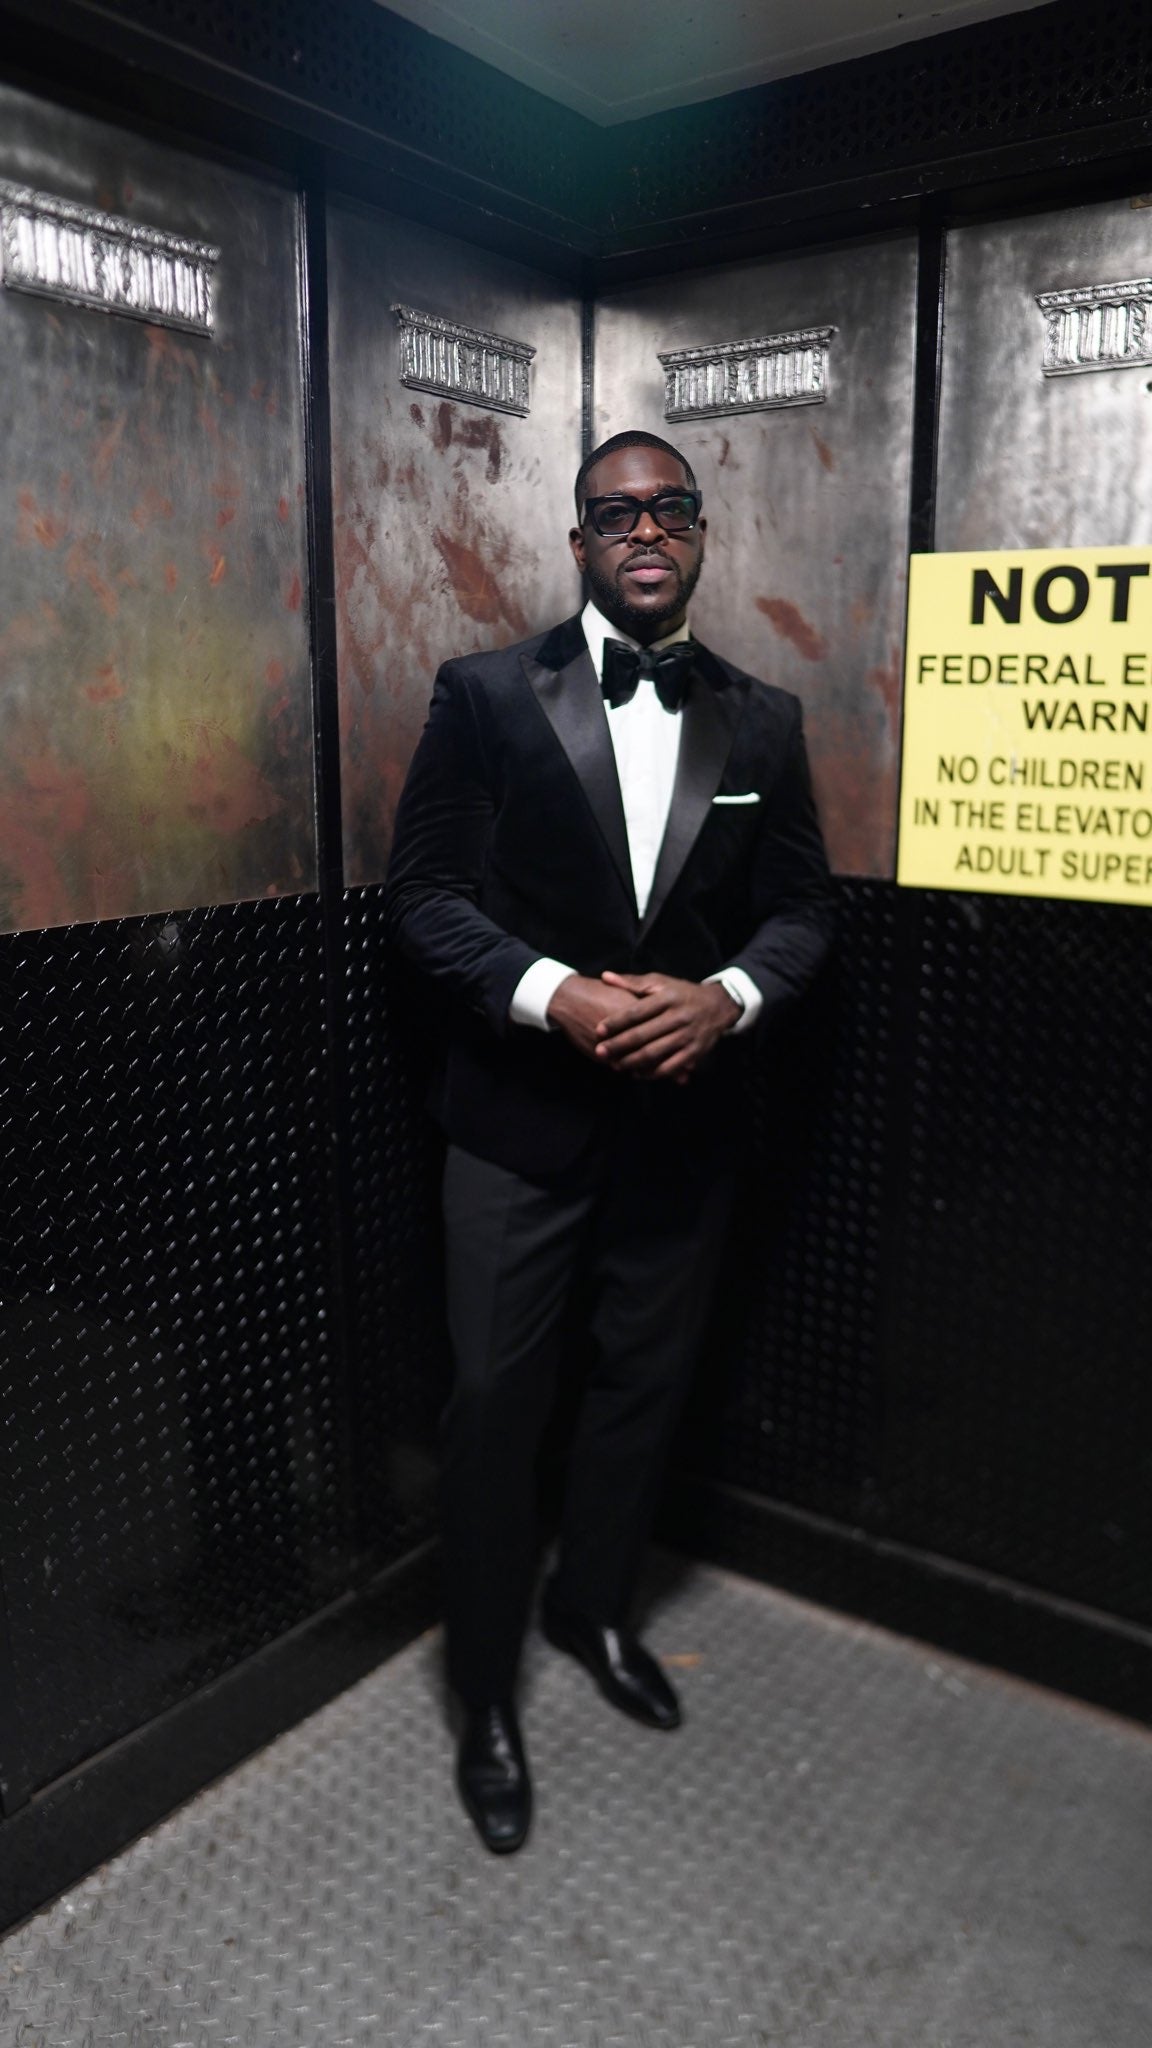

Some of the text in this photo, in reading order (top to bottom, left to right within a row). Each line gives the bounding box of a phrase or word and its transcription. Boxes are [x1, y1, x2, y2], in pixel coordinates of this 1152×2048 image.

[969, 562, 1151, 626] NOT
[917, 653, 1152, 686] FEDERAL E
[1022, 700, 1150, 734] WARN
[937, 755, 1144, 791] NO CHILDREN
[914, 799, 1152, 839] IN THE ELEVATO
[954, 844, 1051, 878] ADULT
